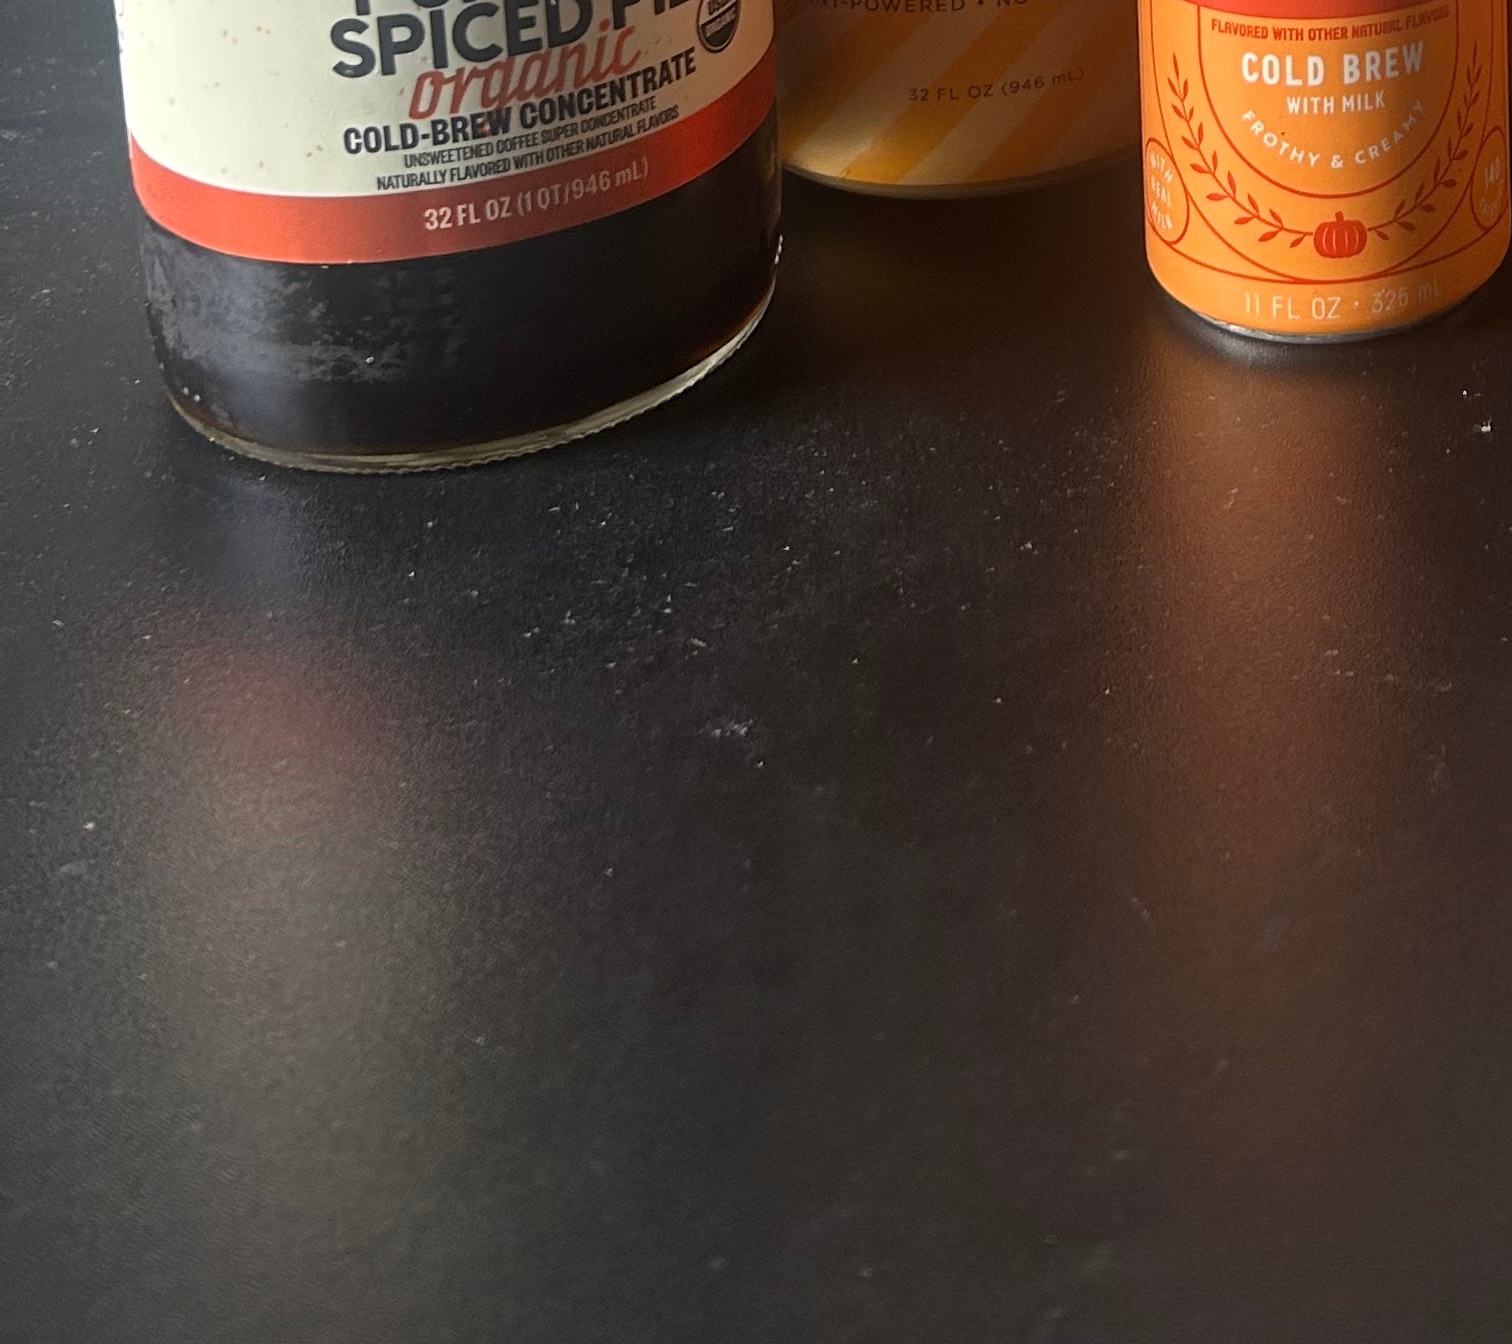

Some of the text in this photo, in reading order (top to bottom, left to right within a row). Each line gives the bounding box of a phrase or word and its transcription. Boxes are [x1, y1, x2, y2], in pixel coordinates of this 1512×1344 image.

[1211, 18, 1268, 40] FLAVORED
[1272, 26, 1304, 41] WITH
[1308, 25, 1349, 42] OTHER
[1352, 19, 1403, 39] NATURAL
[1241, 41, 1424, 87] COLD BREW
[343, 46, 697, 157] COLD-BREW CONCENTRATE
[408, 17, 643, 132] organic
[908, 75, 1045, 102] 32 FL OZ (946
[1286, 89, 1386, 115] WITH MILK
[377, 104, 680, 193] NATURALLY FLAVORED WITH OTHER NATURAL FLAVORS
[403, 95, 657, 170] UNSWEETENED COFFEE SUPER CONCENTRATE
[1241, 109, 1321, 168] FROTHY
[1330, 154, 1344, 169] &
[1354, 100, 1424, 165] CREAMY
[424, 206, 453, 232] 32
[455, 202, 481, 227] FL
[485, 195, 512, 222] OZ
[614, 156, 649, 188] mL)
[1243, 286, 1410, 321] 11 FL OZ 325
